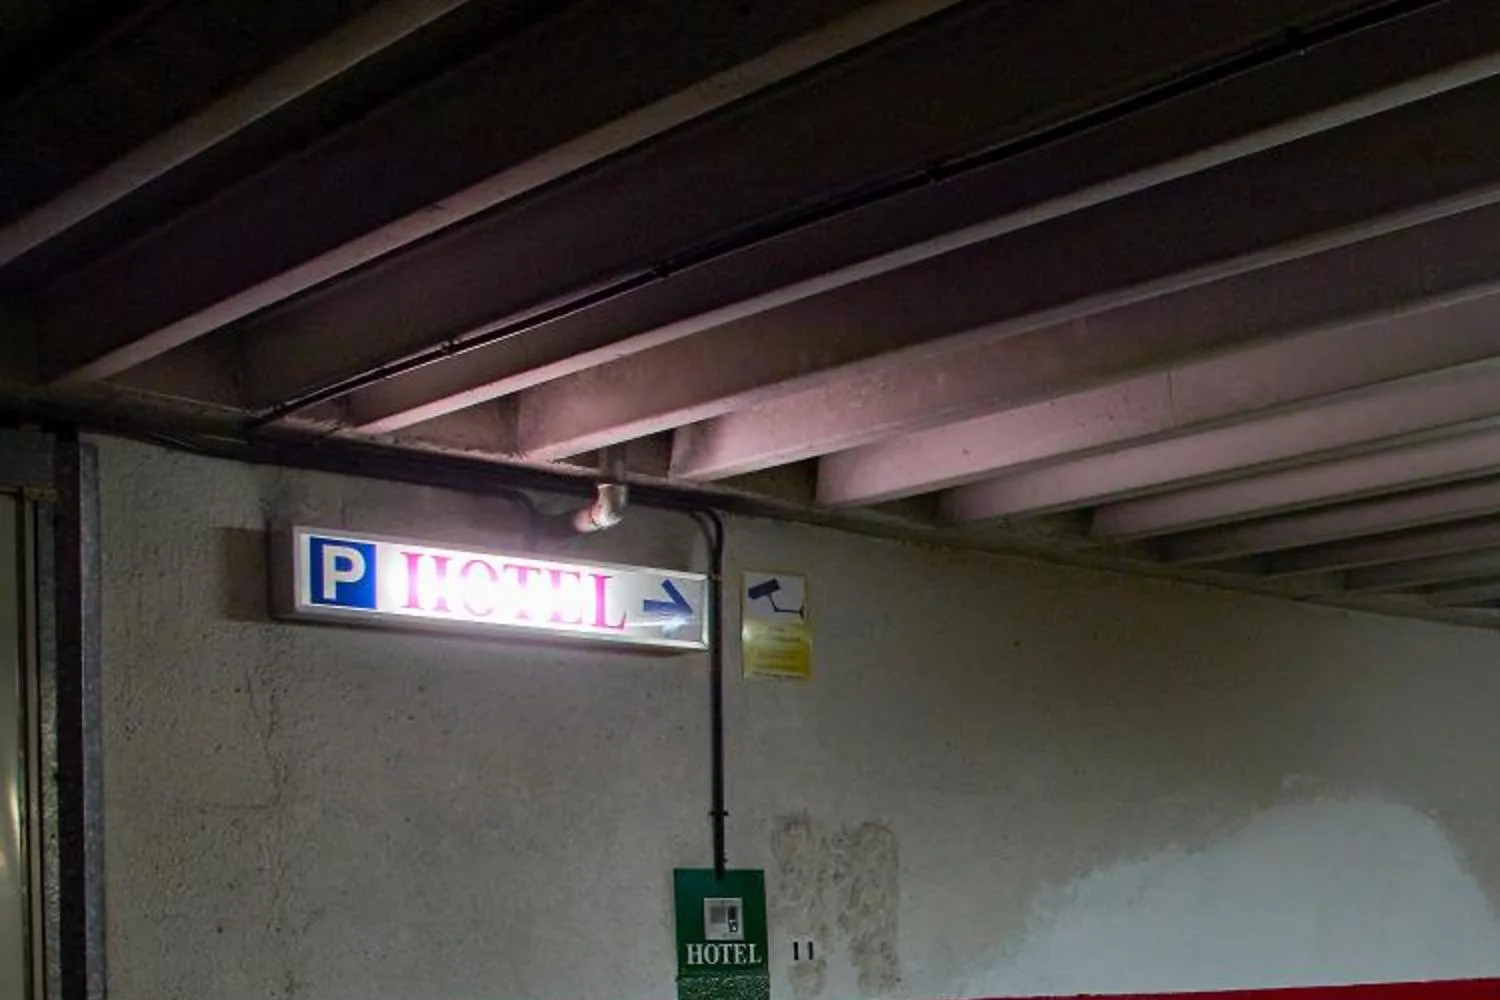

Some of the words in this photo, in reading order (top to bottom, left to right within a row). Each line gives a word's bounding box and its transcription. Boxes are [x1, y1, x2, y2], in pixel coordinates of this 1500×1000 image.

[322, 544, 367, 600] P
[400, 551, 627, 630] HOTEL
[686, 943, 762, 965] HOTEL
